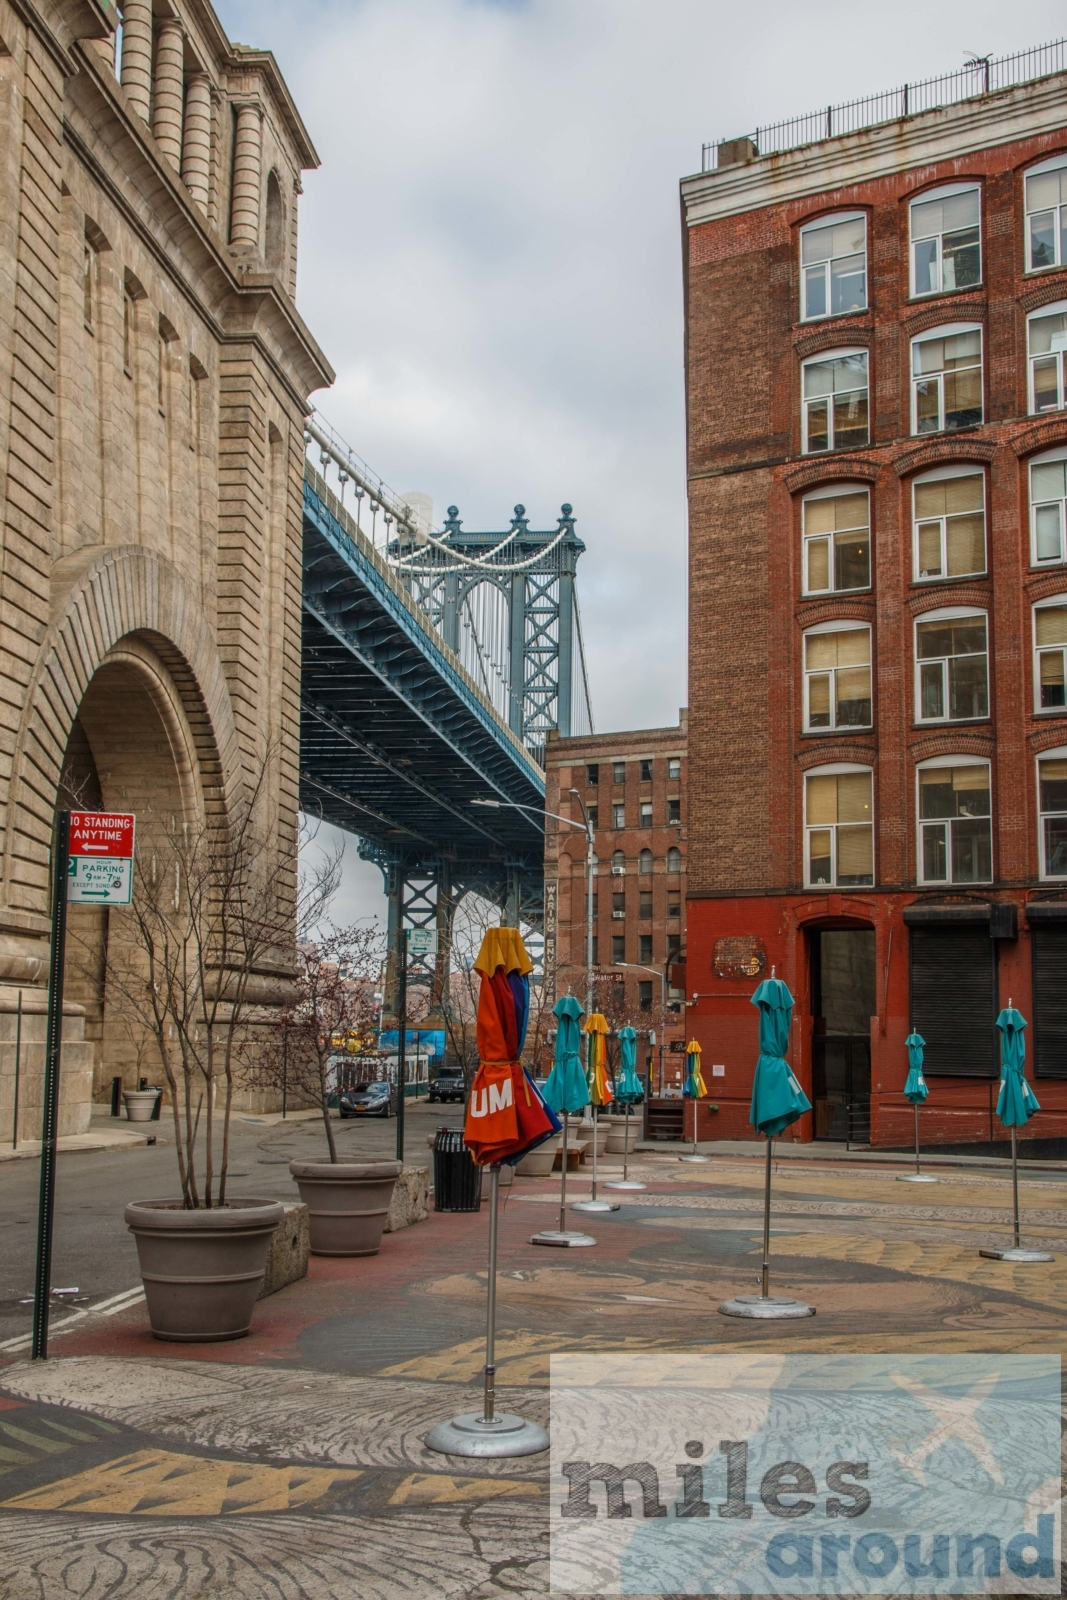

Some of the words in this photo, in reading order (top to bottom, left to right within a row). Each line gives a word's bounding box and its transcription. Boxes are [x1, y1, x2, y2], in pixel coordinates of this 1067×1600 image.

[84, 817, 130, 828] STANDING
[74, 830, 122, 840] ANYTIME
[82, 864, 124, 873] PARKING
[546, 886, 556, 932] WARING
